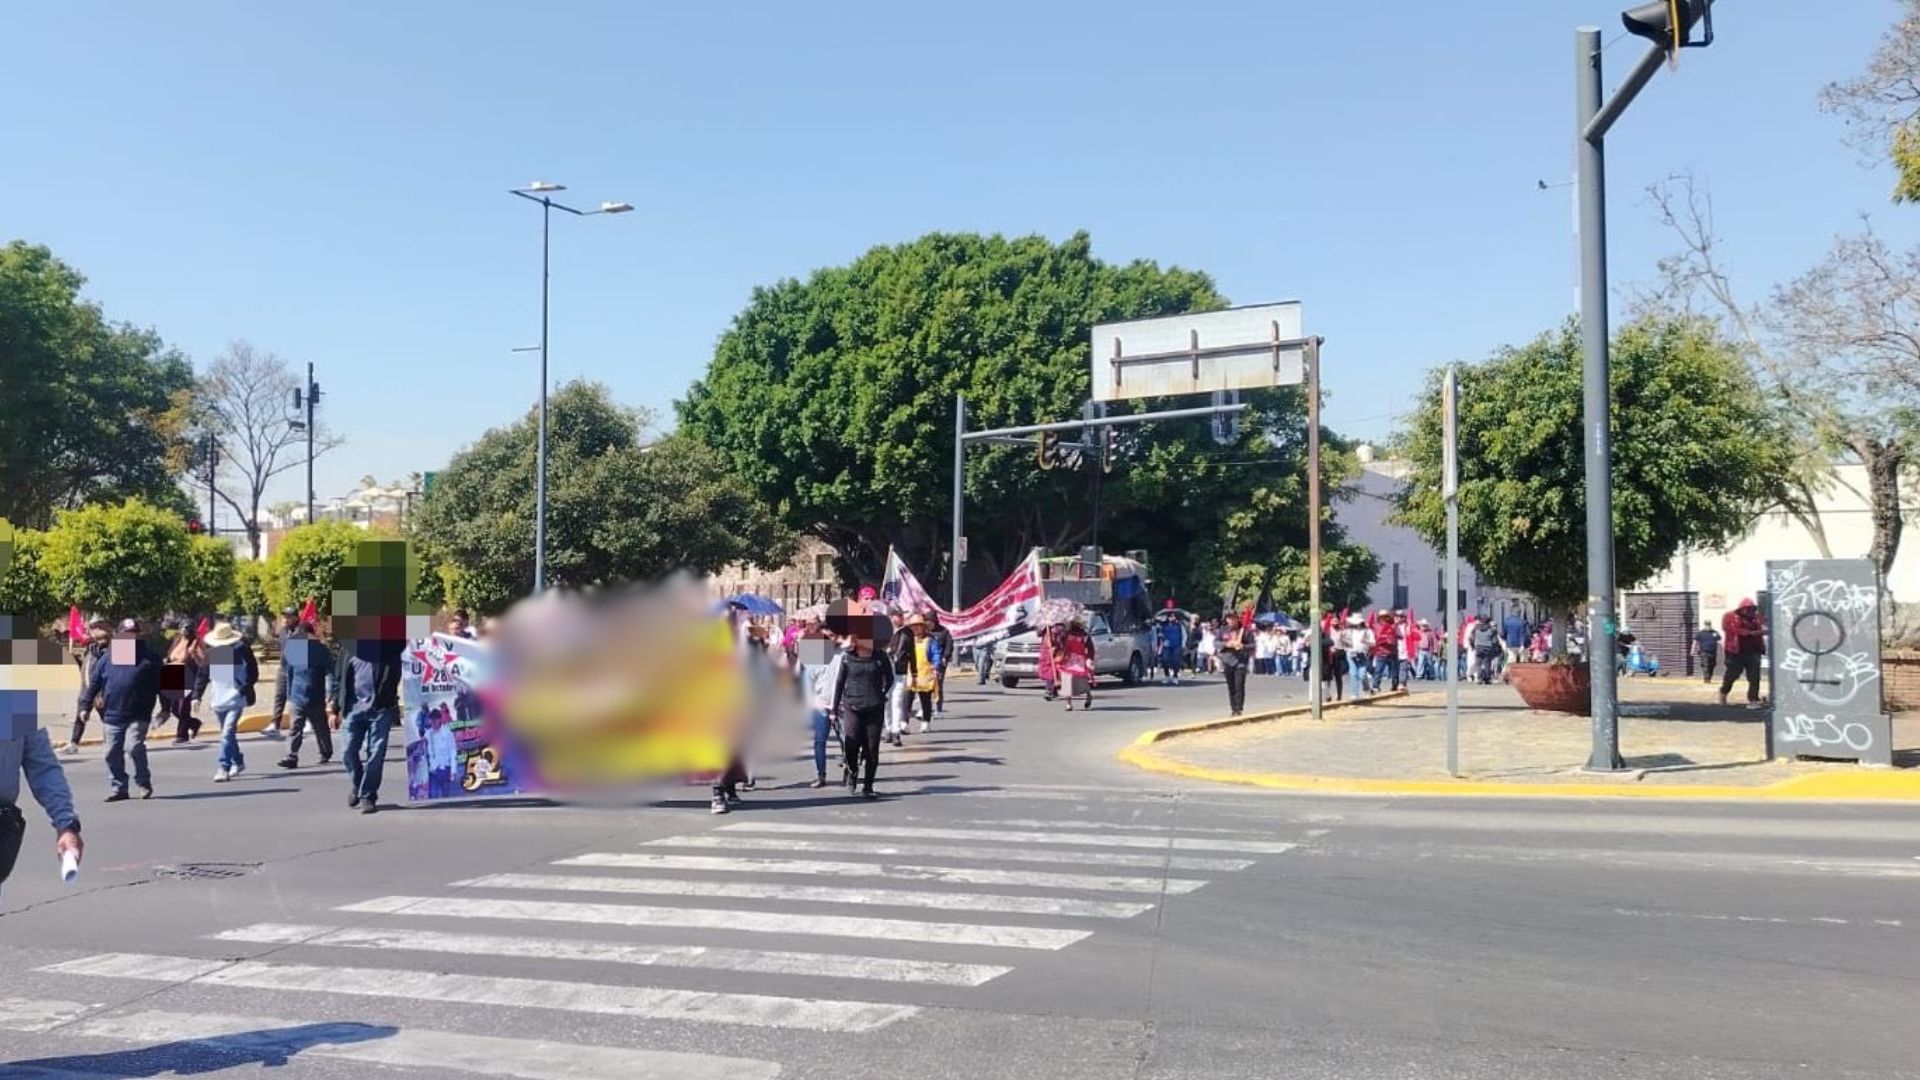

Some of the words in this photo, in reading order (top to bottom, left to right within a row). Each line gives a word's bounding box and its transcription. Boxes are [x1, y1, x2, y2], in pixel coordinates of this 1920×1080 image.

[411, 661, 422, 675] U
[451, 663, 461, 677] A
[433, 668, 448, 683] 28
